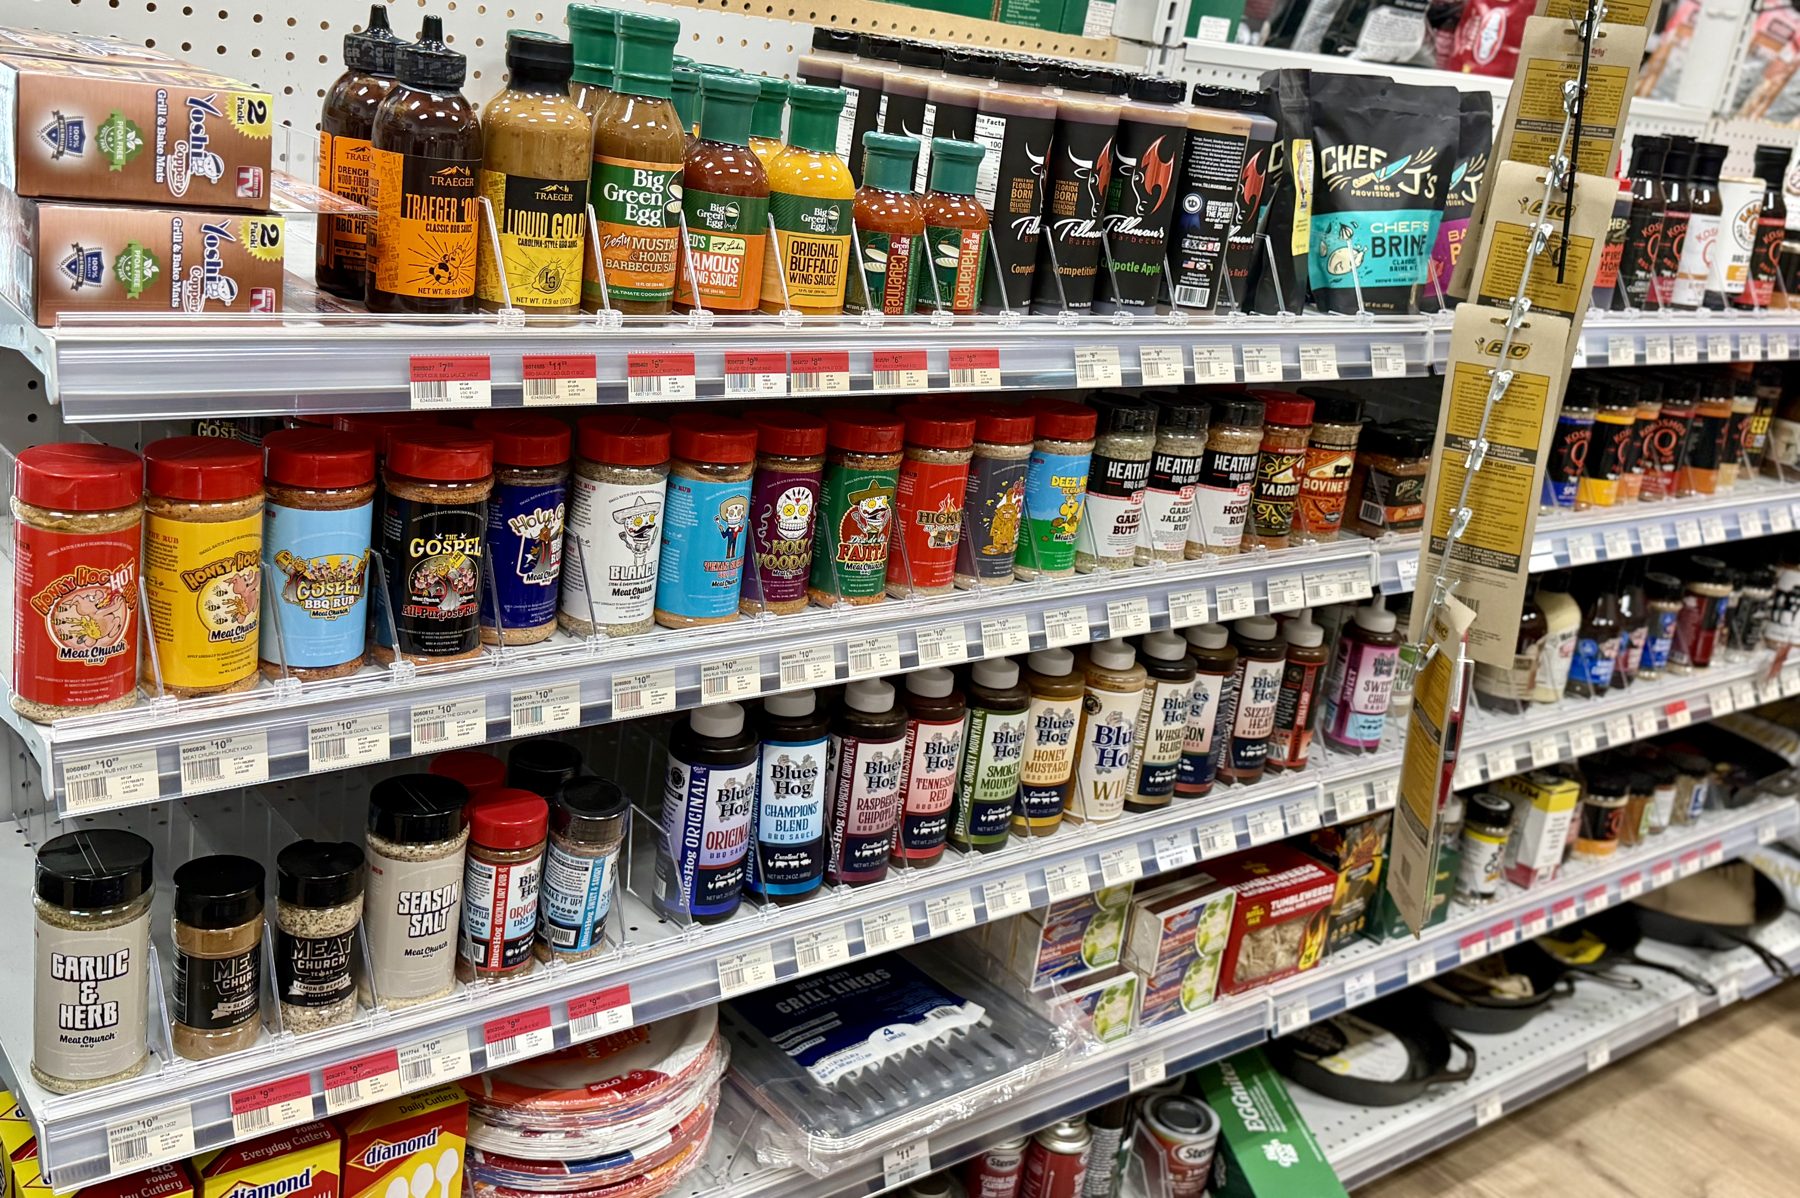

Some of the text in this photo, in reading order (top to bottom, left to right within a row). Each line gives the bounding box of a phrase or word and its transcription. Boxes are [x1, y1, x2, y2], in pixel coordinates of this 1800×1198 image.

[247, 100, 267, 124] 2
[156, 89, 167, 183] Grill & Bake Mats
[116, 143, 124, 160] FREE
[174, 140, 189, 194] Copper
[1320, 144, 1387, 179] CHEF
[430, 175, 474, 187] TRAEGER
[634, 169, 664, 191] Big
[1373, 184, 1391, 192] BBQ
[535, 192, 573, 202] TRAEGER
[604, 183, 663, 206] Green
[1011, 189, 1033, 199] BORN
[1054, 191, 1078, 202] BORN
[1351, 190, 1400, 198] PROVISIONS
[406, 193, 458, 222] TRAEGER
[625, 204, 662, 227] Egg
[697, 209, 725, 222] Green
[710, 203, 725, 213] Big
[814, 207, 828, 217] Big
[508, 209, 584, 238] LIQUID GOLD
[706, 219, 723, 230] Egg
[801, 213, 827, 225] Green
[810, 221, 827, 232] Egg
[1103, 214, 1165, 238] Tillman's
[1370, 221, 1430, 233] CHEF'S
[250, 221, 258, 248] Pack!
[260, 224, 280, 248] 2
[425, 223, 449, 233] CLASSIC
[517, 237, 558, 248] CAROLINA-STYLE
[603, 232, 631, 249] Zesty
[1371, 234, 1427, 259] BRINE
[639, 252, 672, 262] HONEY
[791, 240, 839, 258] ORIGINAL
[171, 218, 182, 308] Grill & Bake Mats
[201, 219, 236, 298] Yoshi
[605, 258, 661, 272] BARBECUE
[790, 255, 838, 275] BUFFALO
[1141, 262, 1161, 276] Apple
[710, 273, 738, 287] SAUCE
[789, 272, 837, 286] WING SAUCE
[886, 255, 908, 306] Cayenne
[956, 250, 978, 308] Habanero
[417, 287, 428, 295] NET
[516, 296, 527, 304] NET
[1107, 461, 1143, 479] HEATH
[1155, 455, 1194, 474] HEATH
[1213, 454, 1250, 473] HEATH
[1051, 476, 1077, 487] DEEZ
[1302, 478, 1342, 493] BOVINE
[1395, 479, 1418, 497] CHEF
[508, 506, 554, 532] Holy
[1229, 515, 1245, 525] RUB
[1173, 524, 1187, 532] RUB
[445, 533, 458, 541] THE
[410, 537, 482, 557] GOSPEL
[772, 538, 808, 555] HOLY
[838, 541, 887, 562] FAJITA
[757, 551, 812, 570] VOODOO
[845, 562, 862, 571] Meat
[182, 549, 262, 591] HONEY HOG
[526, 570, 542, 583] Meat
[609, 560, 657, 581] BLANCO
[33, 564, 135, 616] HONEY HOG HOT
[297, 577, 361, 601] GOSPEL
[612, 584, 652, 597] Meat Church
[711, 580, 724, 588] Meat
[304, 596, 355, 611] BBQ RUB
[312, 607, 349, 618] Meat Church
[210, 630, 236, 642] Meat
[60, 640, 127, 659] Meat Church
[1036, 715, 1075, 729] Blues
[969, 718, 983, 759] MOUNTAIN
[993, 730, 1025, 744] Blues
[1038, 729, 1070, 743] Hog
[924, 741, 960, 754] Blues
[995, 744, 1020, 760] Hog
[1033, 749, 1067, 761] HONEY
[926, 755, 955, 770] Hog
[1025, 759, 1068, 773] MUSTARD
[67, 773, 82, 781] MEAT
[771, 764, 818, 780] Blues
[837, 745, 854, 816] RASPBERRY CHIPOTLE
[867, 776, 898, 790] Hog
[717, 784, 753, 802] Blues
[774, 781, 811, 797] Hog
[929, 789, 947, 803] RED
[686, 777, 707, 848] ORIGINAL
[720, 802, 750, 818] Hog
[775, 818, 809, 832] BLEND
[789, 832, 814, 840] SAUCE
[399, 880, 459, 915] SEASON
[1270, 883, 1334, 910] TUMBLEWEEDS
[409, 911, 449, 938] SALT
[291, 934, 353, 959] MEAT
[404, 941, 448, 957] Meat Church
[51, 948, 129, 981] GARLIC
[297, 955, 346, 970] CHURCH
[79, 981, 99, 1004] &
[295, 977, 348, 992] LEMON PEPPER
[775, 968, 892, 1014] GRILL LINERS
[59, 1002, 118, 1031] HERB
[59, 1032, 117, 1044] Meat Church
[884, 1028, 894, 1036] 4
[590, 1078, 622, 1092] SOLO
[398, 1089, 460, 1114] Daily Cutlery
[240, 1127, 333, 1161] Everyday Cutlery
[364, 1128, 439, 1166] diamond
[145, 1171, 178, 1185] FORKS
[230, 1168, 312, 1198] diamond
